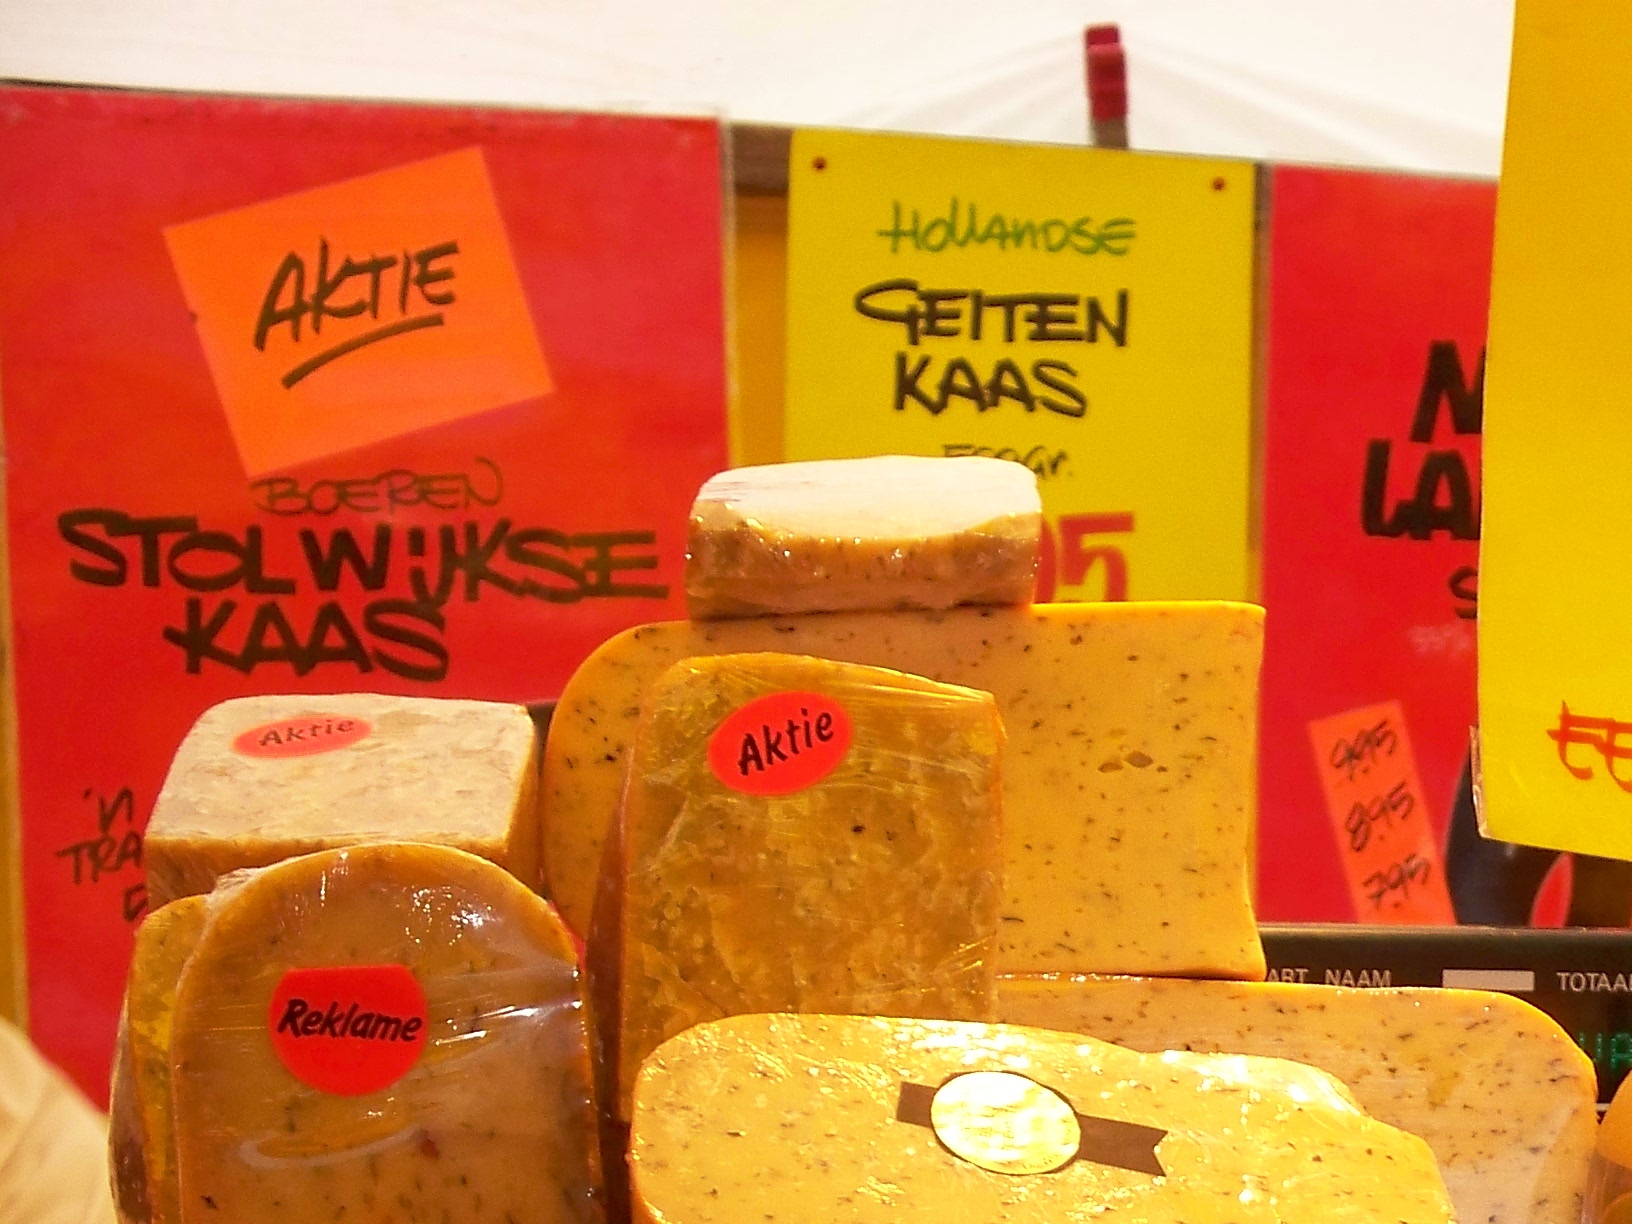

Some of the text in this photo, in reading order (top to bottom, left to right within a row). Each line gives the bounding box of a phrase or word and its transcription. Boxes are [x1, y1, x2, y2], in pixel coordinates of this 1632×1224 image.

[253, 237, 460, 352] AKTIE
[855, 277, 1129, 348] GEITEN
[893, 350, 1089, 418] KAAS
[163, 598, 451, 682] KAAS
[258, 719, 354, 747] Aktie
[737, 707, 834, 776] Aktie
[1323, 968, 1392, 988] NAAM
[277, 997, 424, 1043] Reklame
